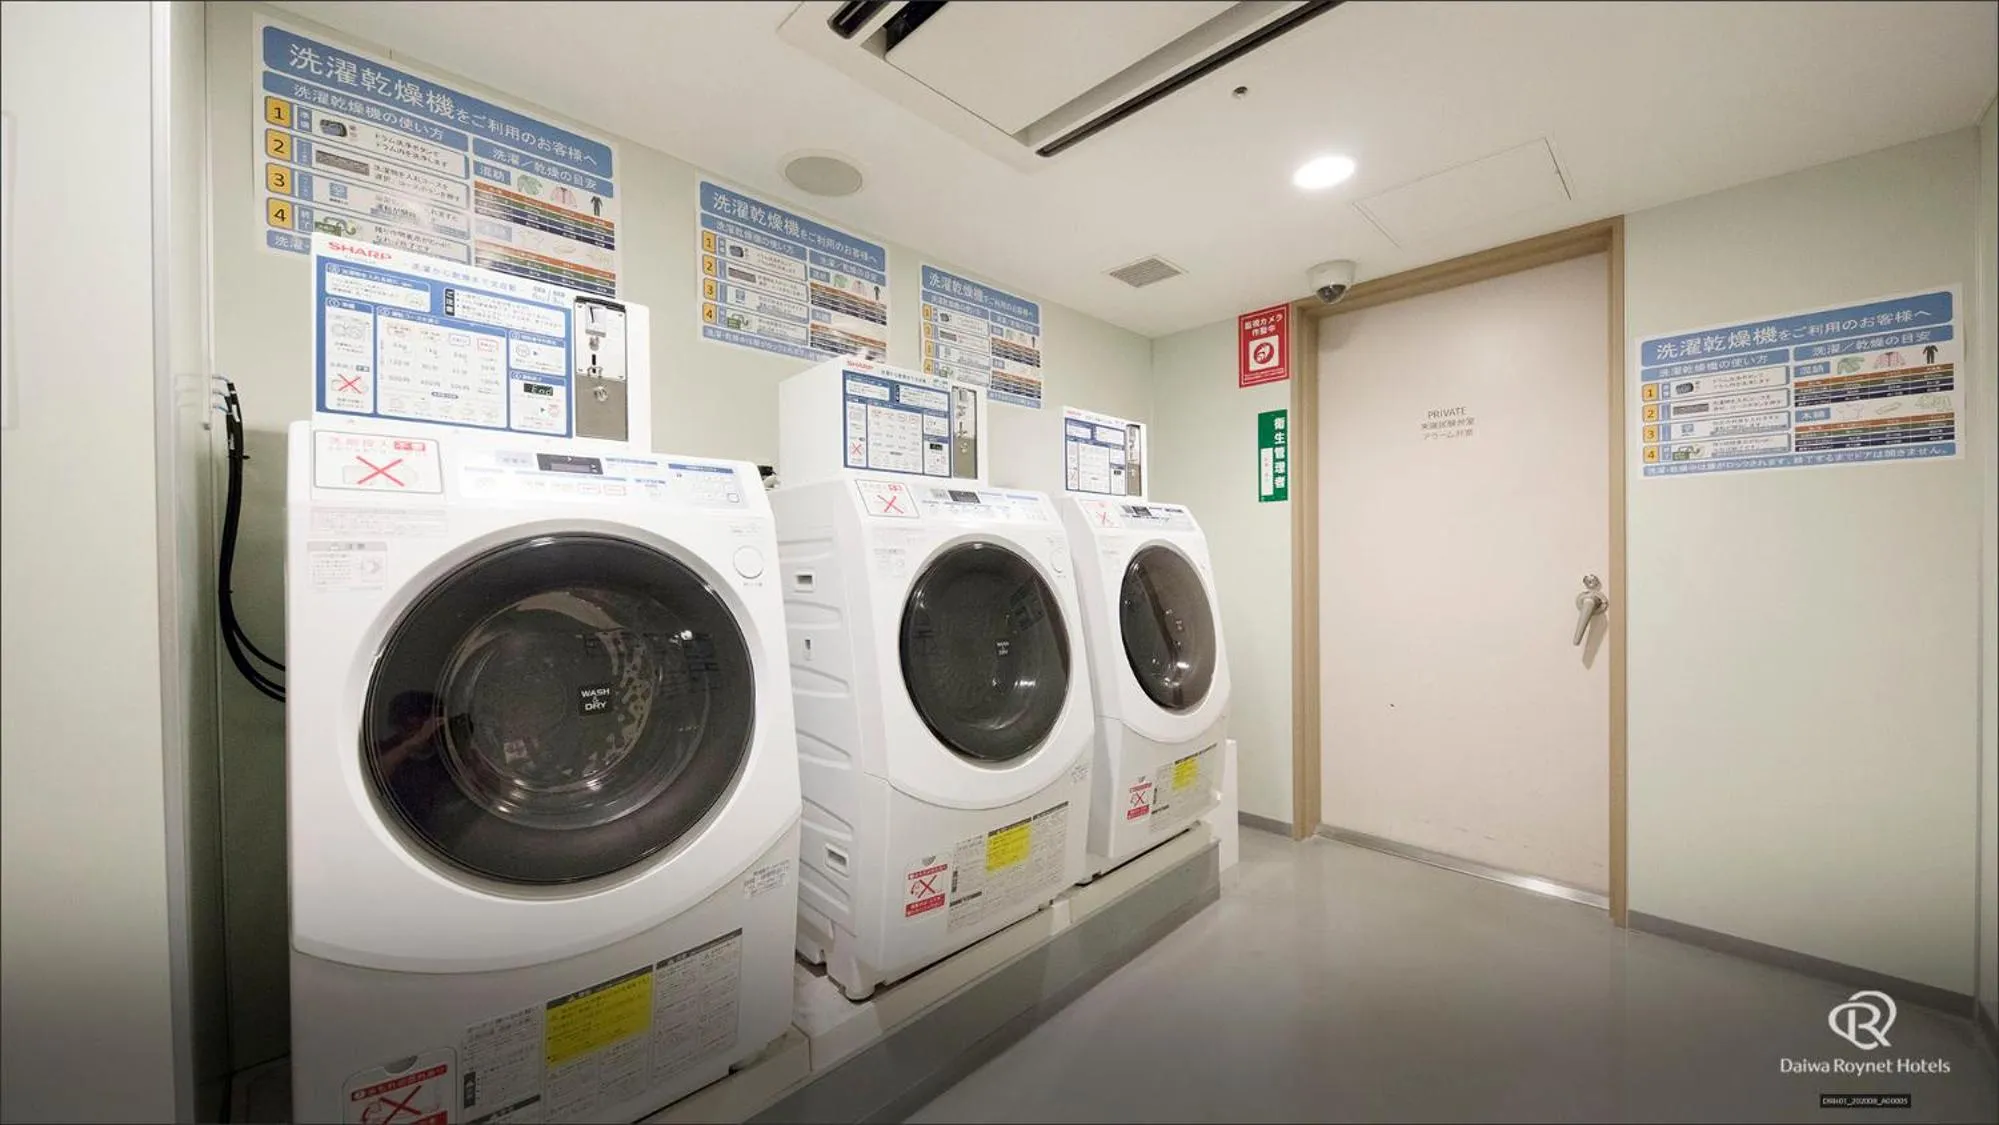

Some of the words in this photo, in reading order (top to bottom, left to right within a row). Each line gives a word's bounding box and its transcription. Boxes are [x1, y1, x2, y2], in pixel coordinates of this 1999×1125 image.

[273, 105, 285, 120] 1
[288, 42, 598, 167] 洗濯乾燥機をご利用のお客様へ
[293, 83, 445, 142] 洗濯乾燥機の使い方
[273, 138, 285, 154] 2
[273, 172, 285, 188] 3
[273, 207, 286, 222] 4
[713, 192, 877, 264] 洗濯乾燥機をご利用のお客様へ
[328, 240, 393, 260] SHARP
[1656, 309, 1932, 360] 洗濯乾燥機をご利用のお客様へ
[1428, 406, 1467, 418] PRIVATE
[1273, 416, 1286, 489] 衛生管理者
[580, 688, 610, 698] WASH
[584, 701, 608, 711] DRY
